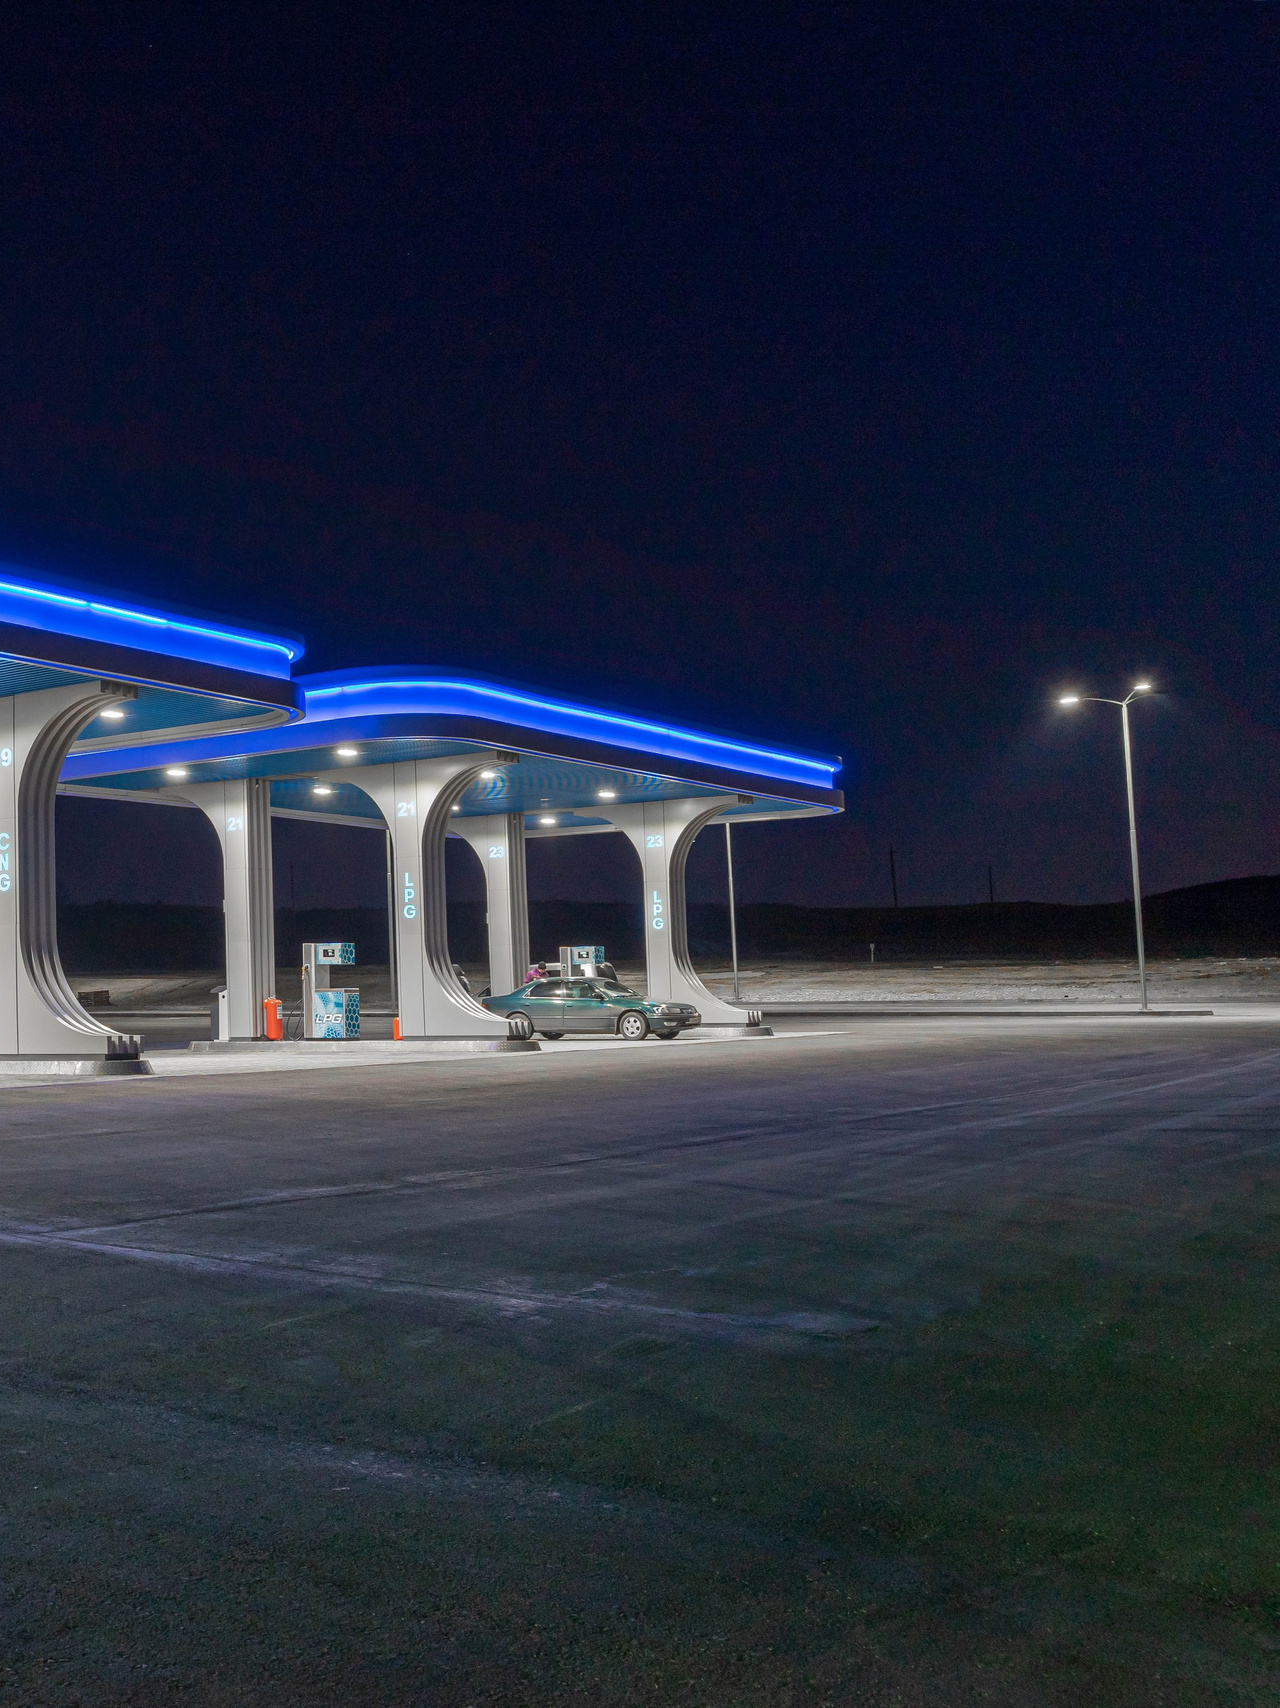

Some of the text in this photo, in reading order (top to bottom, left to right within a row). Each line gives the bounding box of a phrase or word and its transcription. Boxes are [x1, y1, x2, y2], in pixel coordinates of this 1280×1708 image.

[397, 801, 416, 818] 21
[226, 816, 244, 831] 21
[646, 835, 663, 848] 23
[488, 846, 505, 859] 23
[403, 872, 416, 919] LPG
[652, 890, 664, 930] LPG
[315, 1013, 342, 1024] LPG
